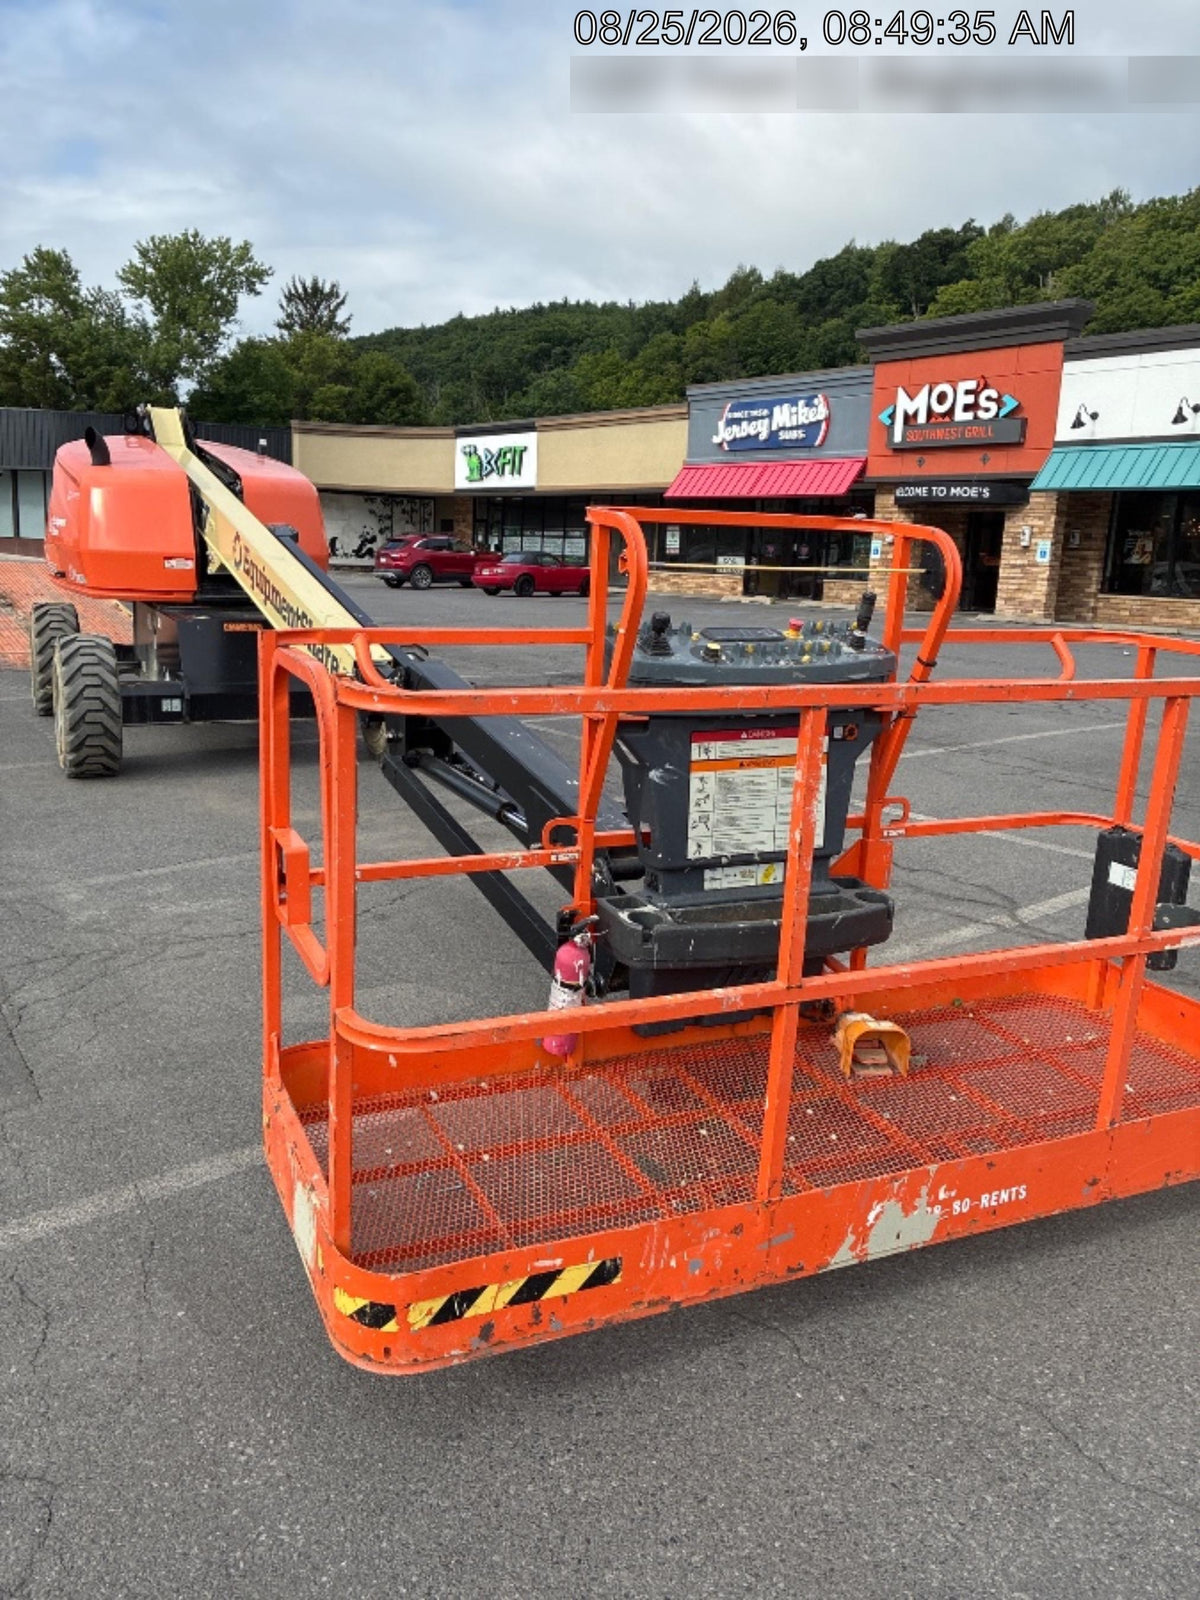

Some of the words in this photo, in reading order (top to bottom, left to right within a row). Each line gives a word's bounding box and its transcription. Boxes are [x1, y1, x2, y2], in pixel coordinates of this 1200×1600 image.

[711, 419, 770, 444] Jersey
[906, 426, 962, 442] SOUTHWEST
[964, 425, 995, 438] GRILL
[931, 486, 947, 497] TO
[950, 486, 990, 499] MOE'S
